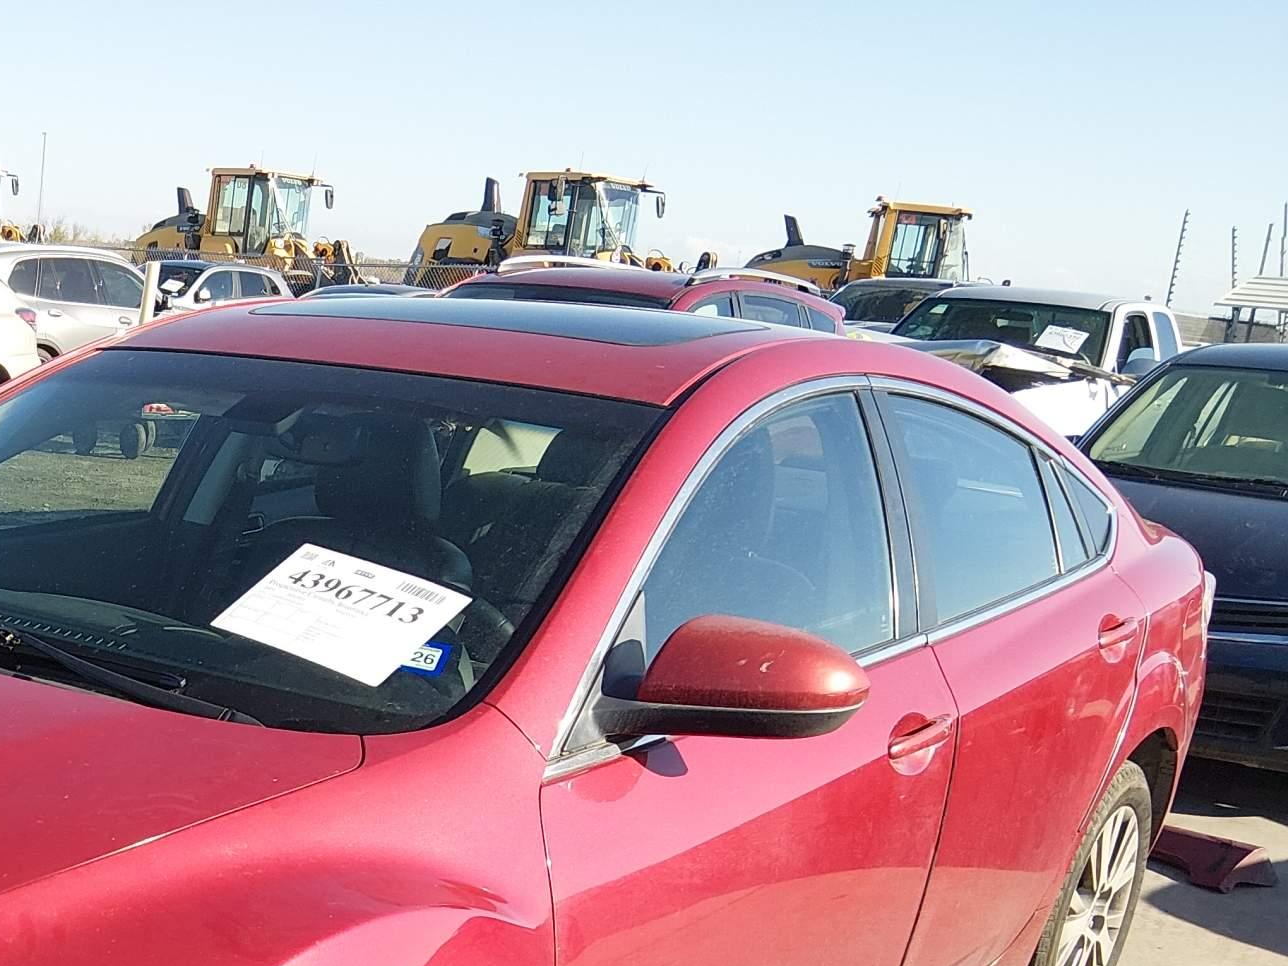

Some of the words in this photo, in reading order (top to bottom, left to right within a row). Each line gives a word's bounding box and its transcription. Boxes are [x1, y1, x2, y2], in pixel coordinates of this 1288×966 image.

[281, 177, 303, 186] VOLVO
[610, 182, 632, 191] VOLVO
[288, 569, 424, 623] 43967713
[410, 651, 436, 665] 26
